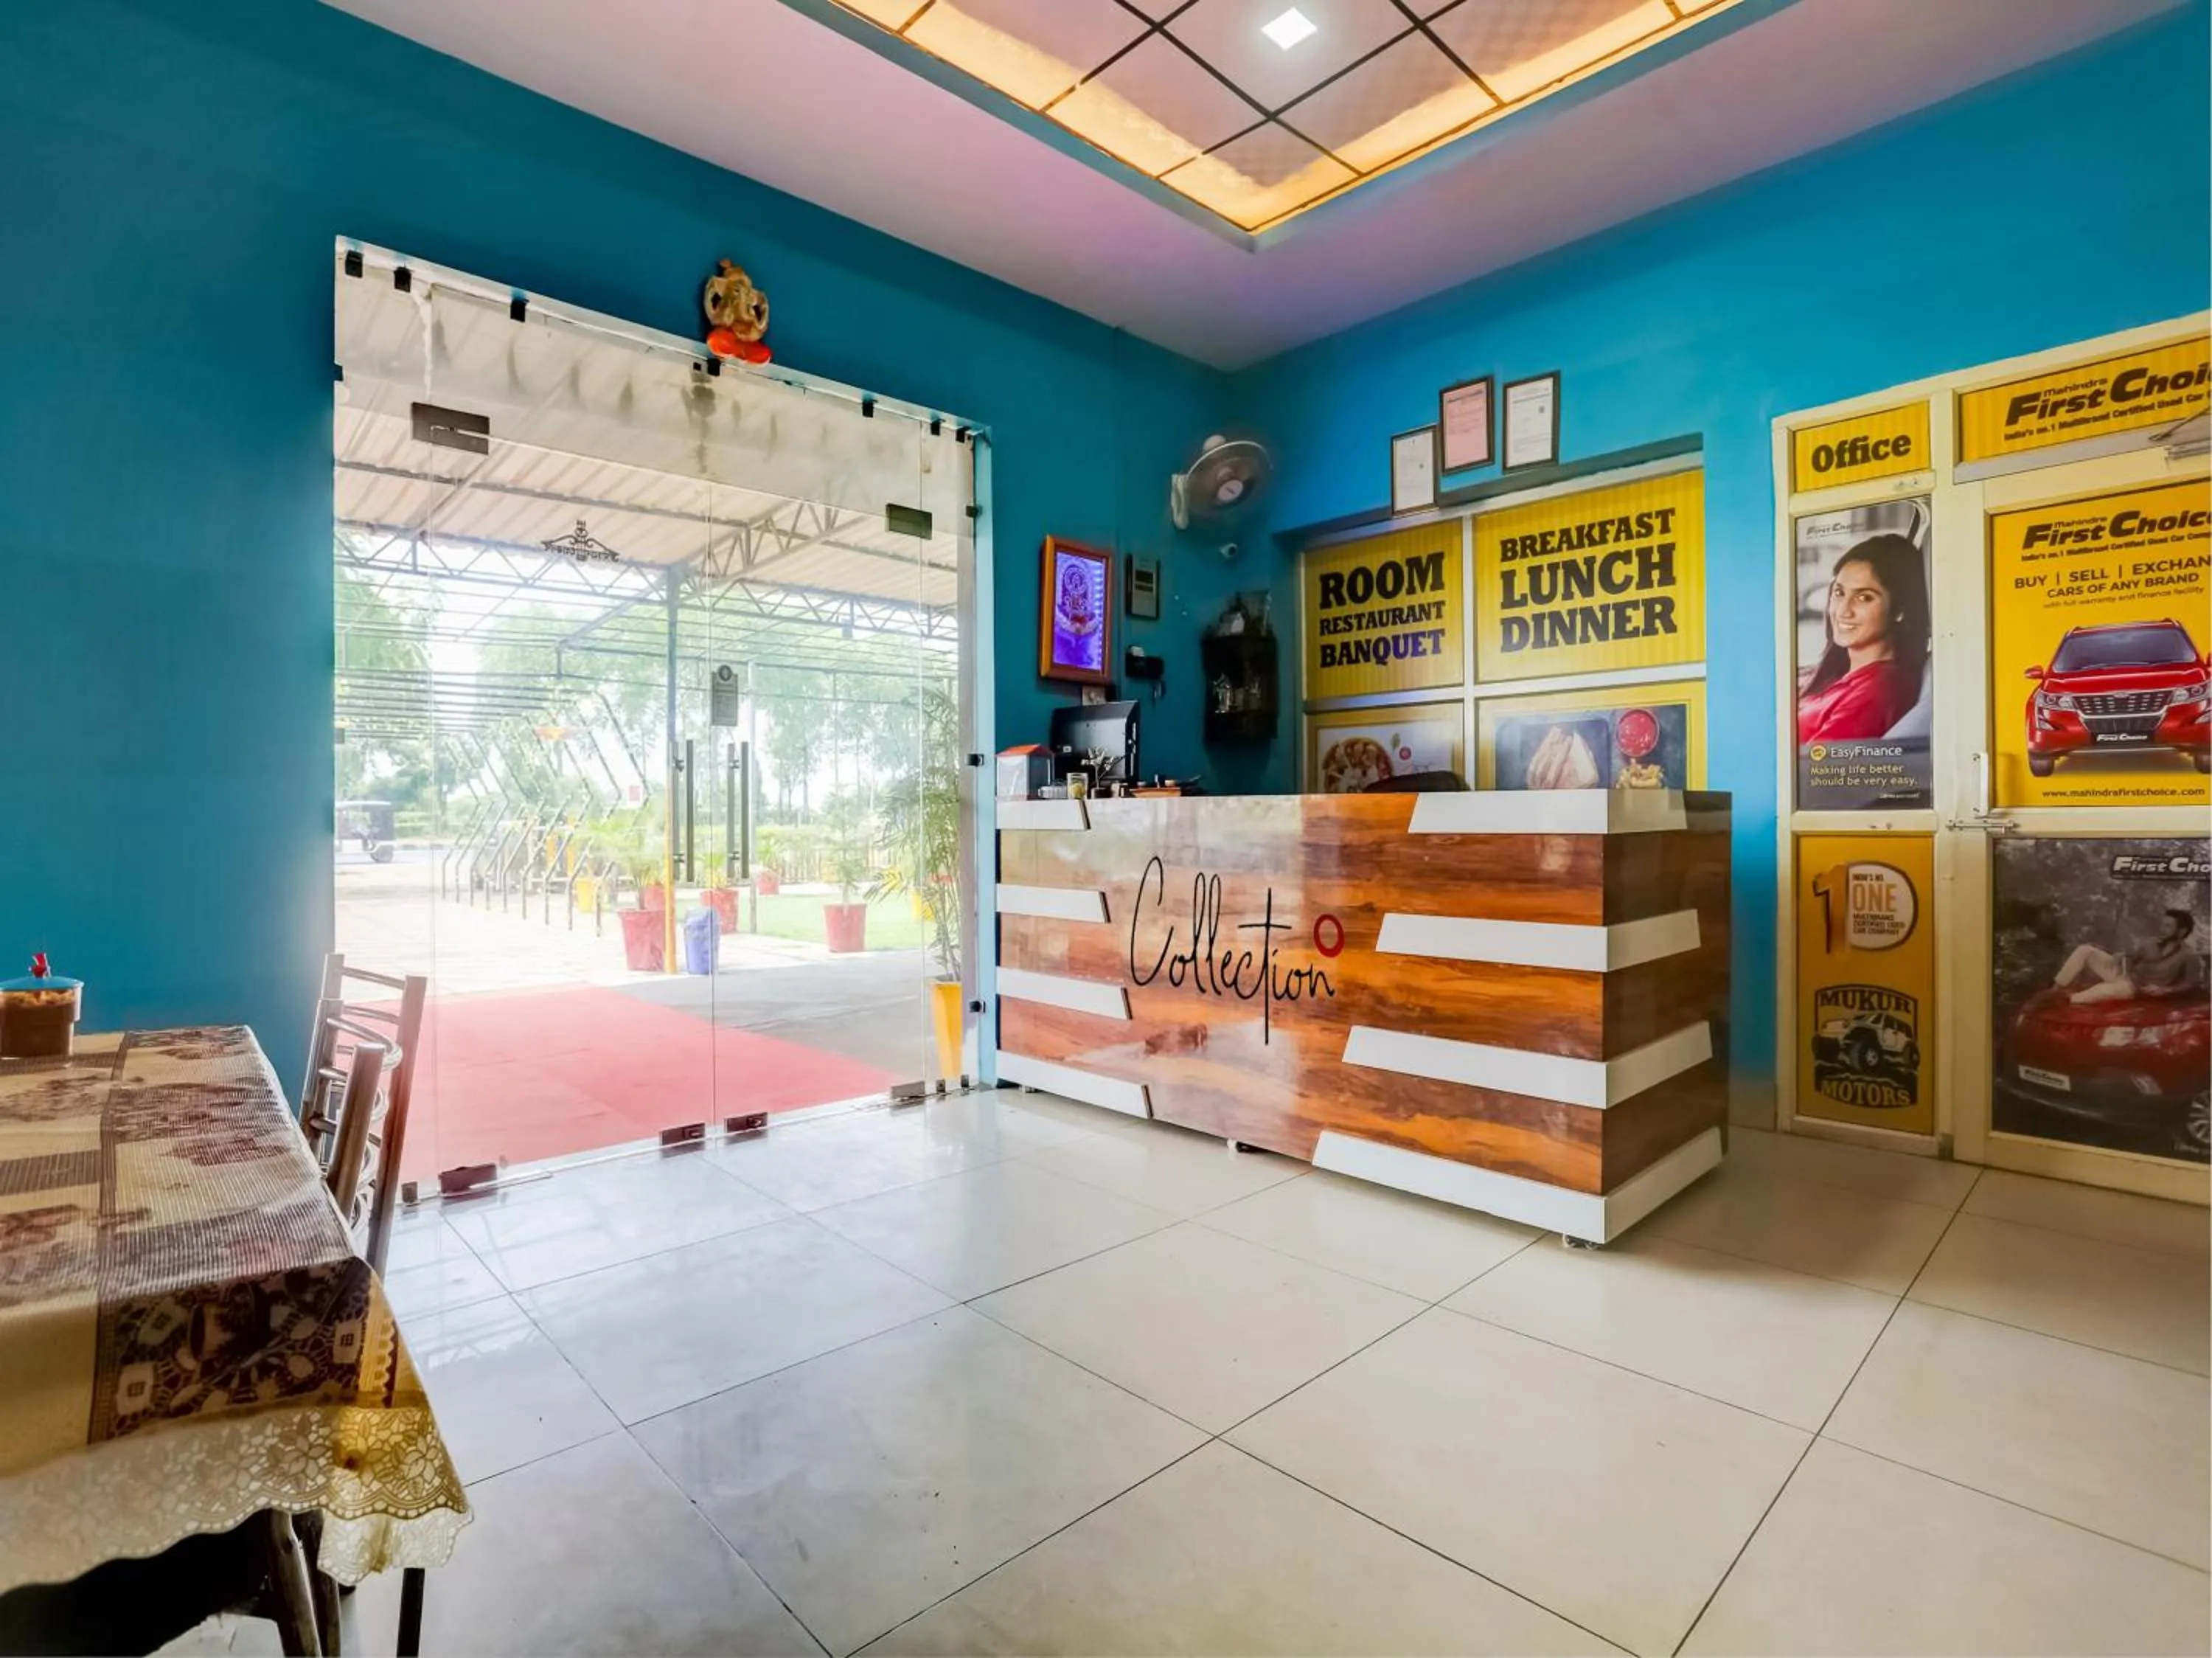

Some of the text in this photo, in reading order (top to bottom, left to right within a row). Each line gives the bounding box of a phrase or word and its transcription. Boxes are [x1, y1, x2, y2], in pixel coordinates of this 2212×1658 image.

[2005, 361, 2211, 427] First Choi
[2112, 401, 2154, 419] Certified
[2157, 395, 2183, 409] Used
[2185, 392, 2204, 404] Car
[1812, 434, 1912, 473] Office
[1500, 507, 1676, 563] BREAKFAST
[2022, 523, 2107, 550] First
[1319, 551, 1445, 610] ROOM
[1500, 543, 1677, 610] LUNCH
[2014, 554, 2211, 589] BUY SELL EXCHAN
[2047, 572, 2199, 598] CARS OF ANY BRAND
[2079, 594, 2116, 605] warranty
[2118, 593, 2136, 601] and
[2137, 589, 2172, 599] finance
[1319, 600, 1446, 637] RESTAURANT
[1500, 596, 1677, 654] DINNER
[1319, 628, 1445, 669] BANQUET
[1831, 745, 1903, 760] EasyFinance
[1810, 763, 1905, 776] Making life better
[1810, 777, 1844, 787] should
[1846, 776, 1860, 785] be
[1863, 777, 1888, 788] very
[2042, 787, 2206, 798] www.mahindrafirstchoice.com
[2113, 856, 2168, 873] First
[1852, 883, 1898, 913] ONE
[1130, 856, 1335, 1045] Collection
[1818, 989, 1912, 1013] MUKUR
[1820, 1080, 1912, 1106] MOTORS
